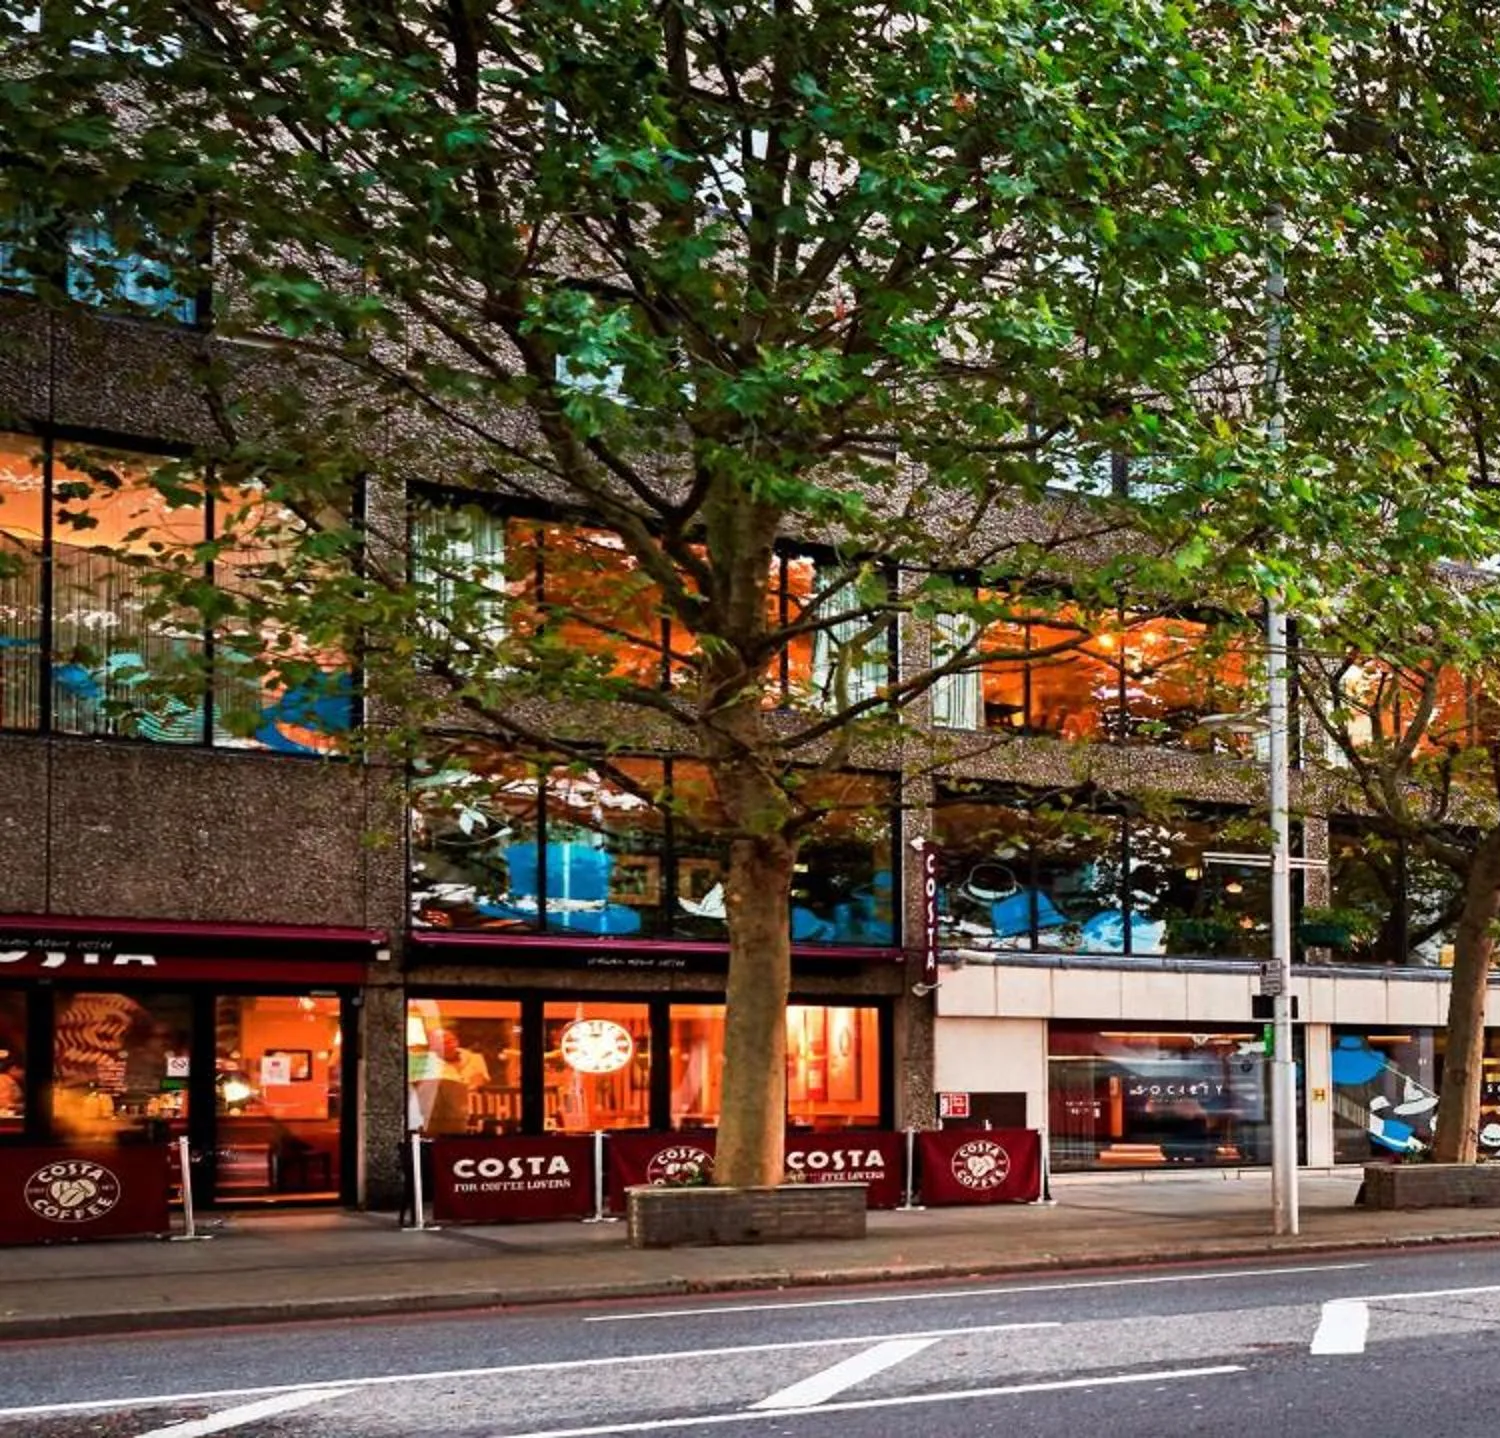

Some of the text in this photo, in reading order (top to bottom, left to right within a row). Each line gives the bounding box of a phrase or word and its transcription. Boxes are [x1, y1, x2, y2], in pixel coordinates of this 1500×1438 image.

[926, 853, 936, 971] COSTA
[1135, 1084, 1223, 1096] SOCIETY
[657, 1148, 705, 1165] COSTA
[786, 1149, 885, 1170] COSTA
[960, 1143, 1000, 1158] COSTA
[38, 1163, 104, 1182] COSTA
[452, 1155, 571, 1179] COSTA
[453, 1179, 571, 1193] FOR COFFEE LOVERS
[957, 1169, 1006, 1188] COFFEE
[33, 1197, 113, 1219] COFFEE
